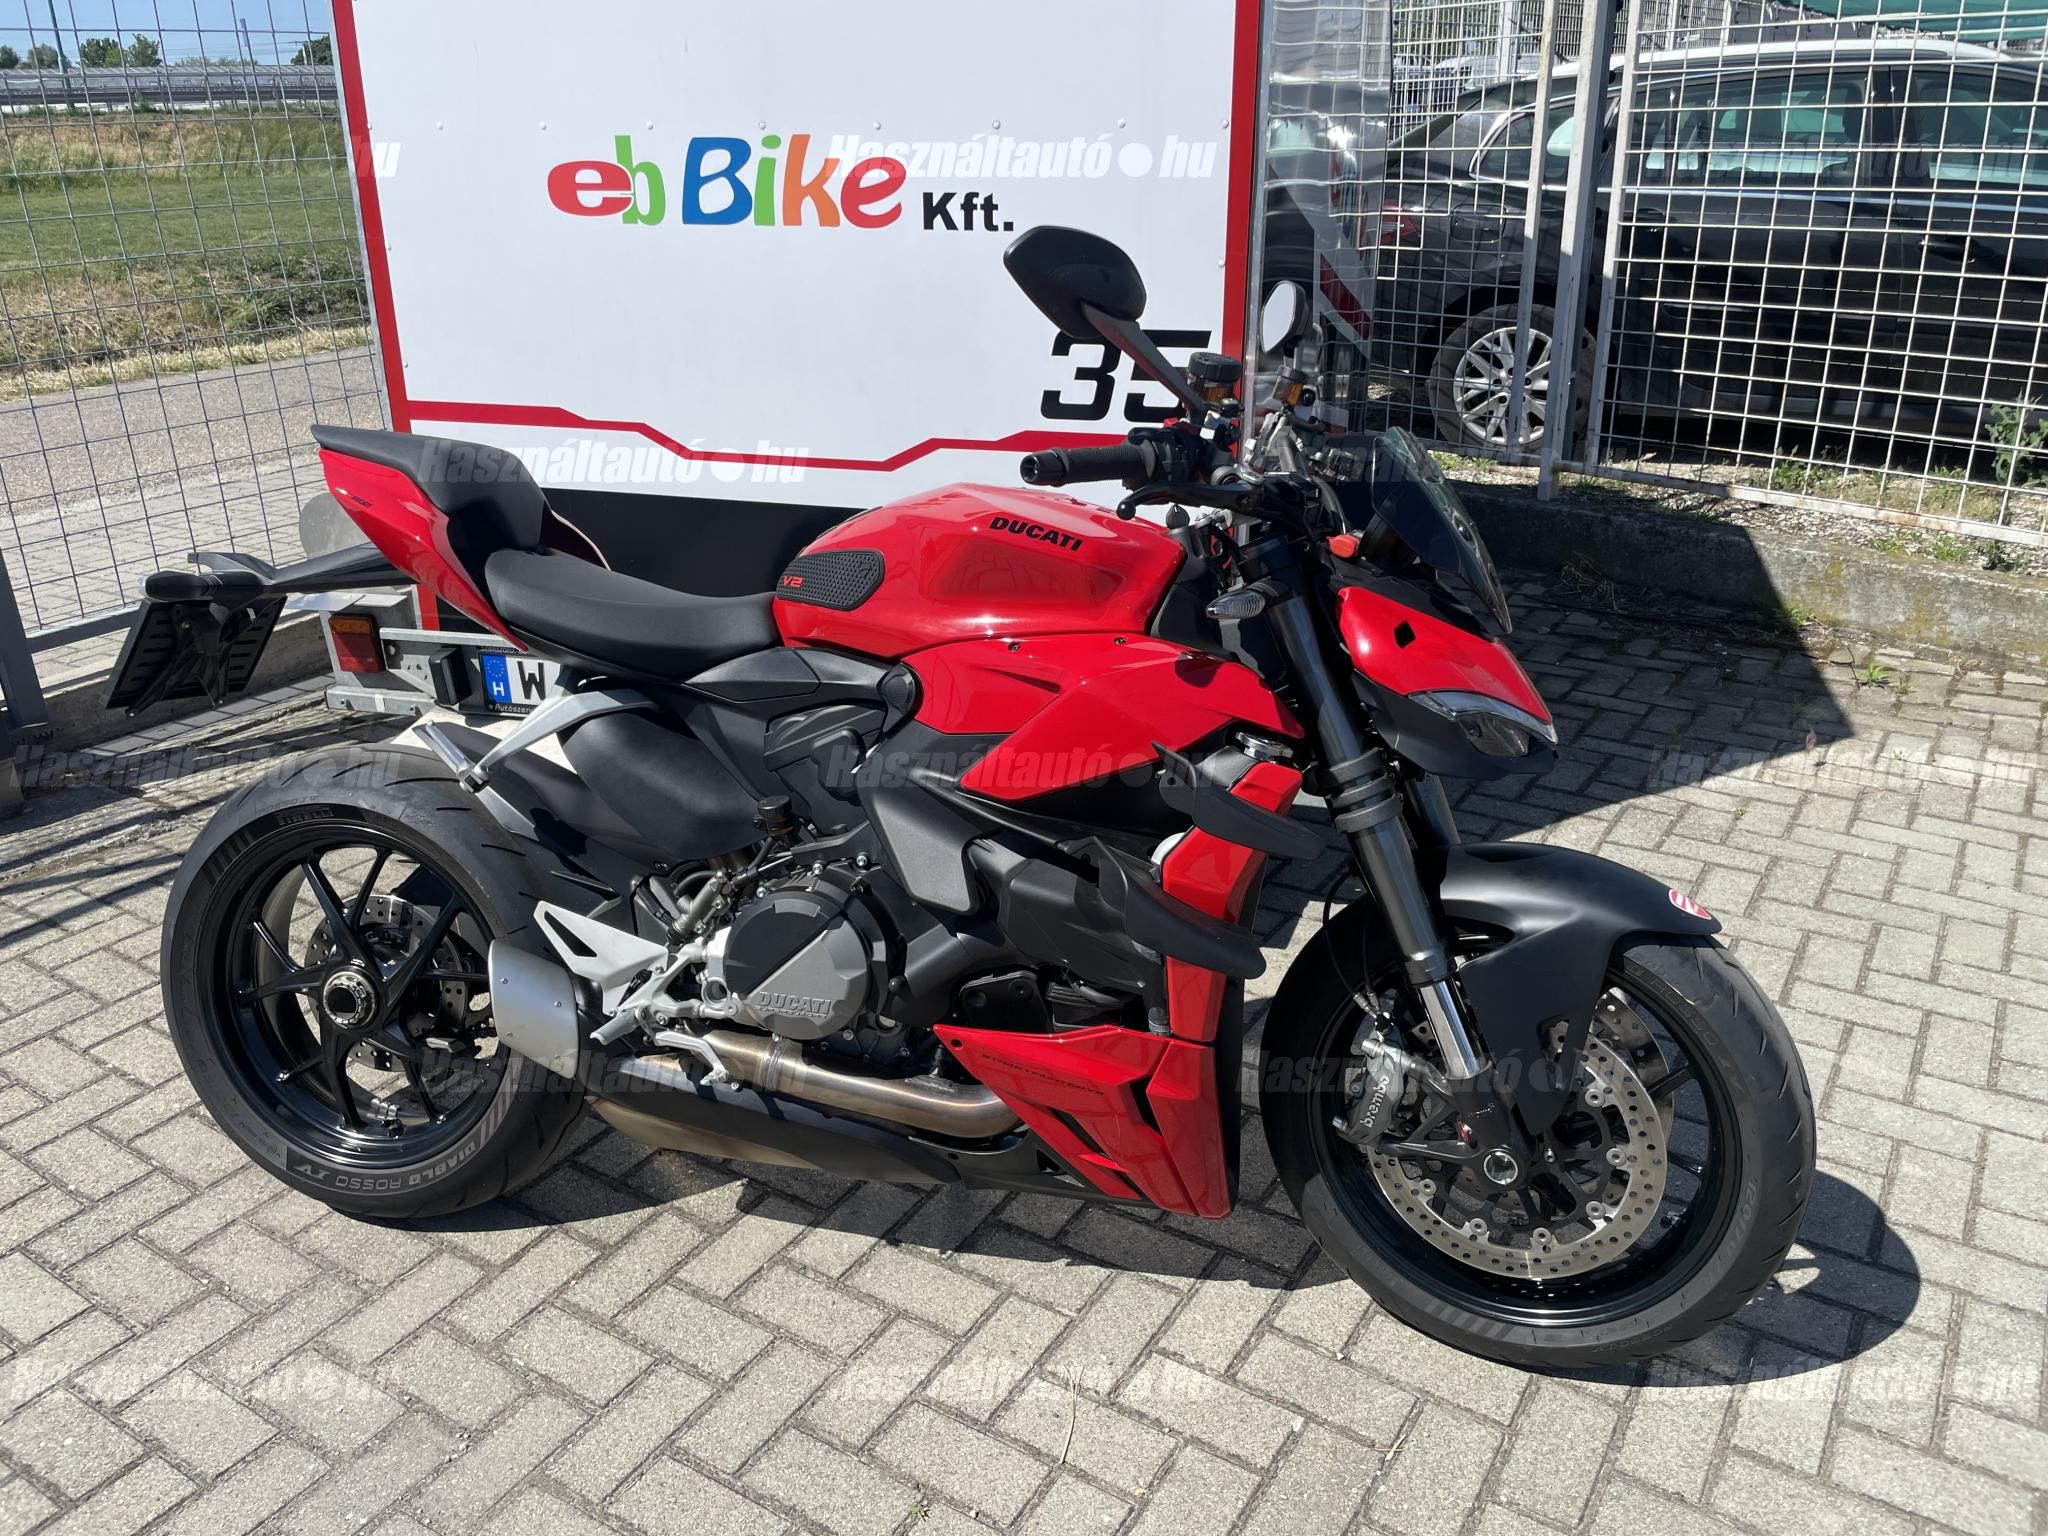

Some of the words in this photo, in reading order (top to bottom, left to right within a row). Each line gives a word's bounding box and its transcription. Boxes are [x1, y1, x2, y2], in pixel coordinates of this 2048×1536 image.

[922, 192, 1015, 231] Kft.
[989, 515, 1083, 553] DUCATI
[783, 576, 803, 588] V2
[493, 681, 505, 697] H
[517, 660, 547, 701] W
[757, 991, 832, 1015] DUCATI
[1359, 1075, 1390, 1128] brembo
[408, 1139, 478, 1186] DIABLO
[335, 1174, 402, 1191] ROSSO
